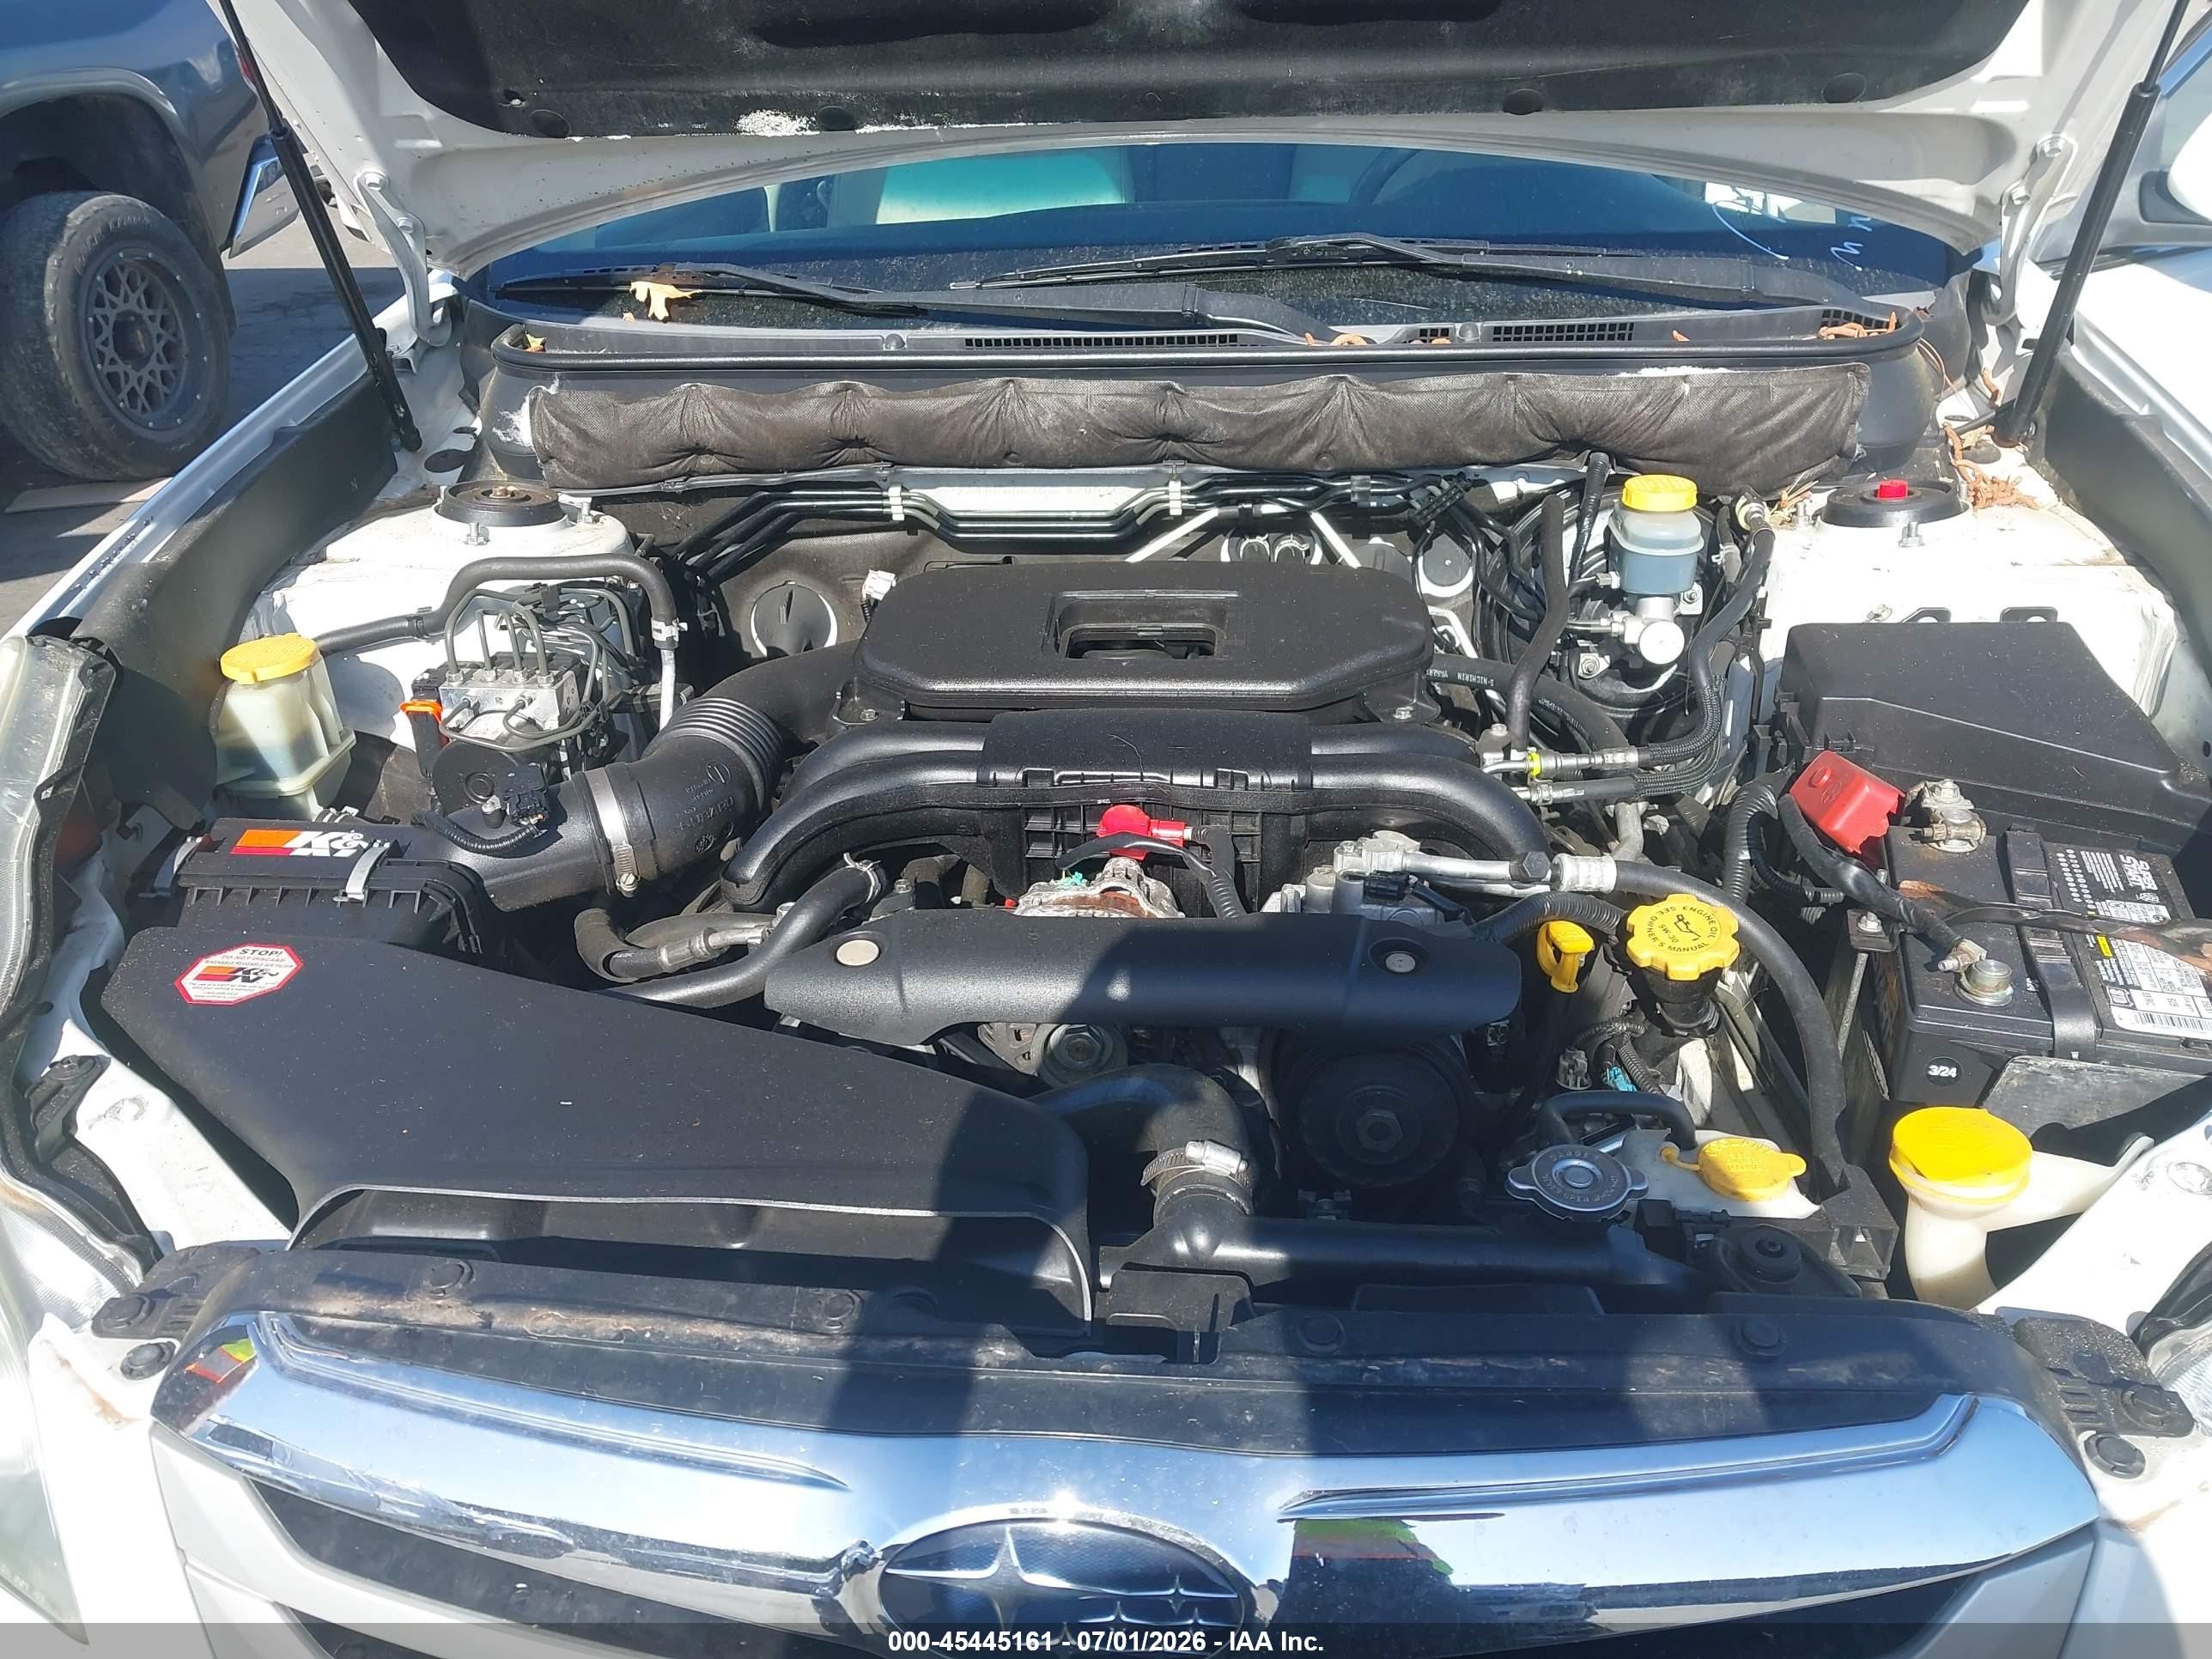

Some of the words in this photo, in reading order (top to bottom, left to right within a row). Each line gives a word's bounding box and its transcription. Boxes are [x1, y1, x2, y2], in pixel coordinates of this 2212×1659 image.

[2119, 854, 2146, 890] START
[2137, 860, 2158, 890] SUPER
[1656, 906, 1676, 916] SEE
[1667, 942, 1710, 952] MANUAL
[1682, 905, 1717, 926] ENGINE
[1708, 927, 1718, 939] OIL
[239, 948, 283, 957] STOP!
[1928, 1065, 1957, 1079] 3/24
